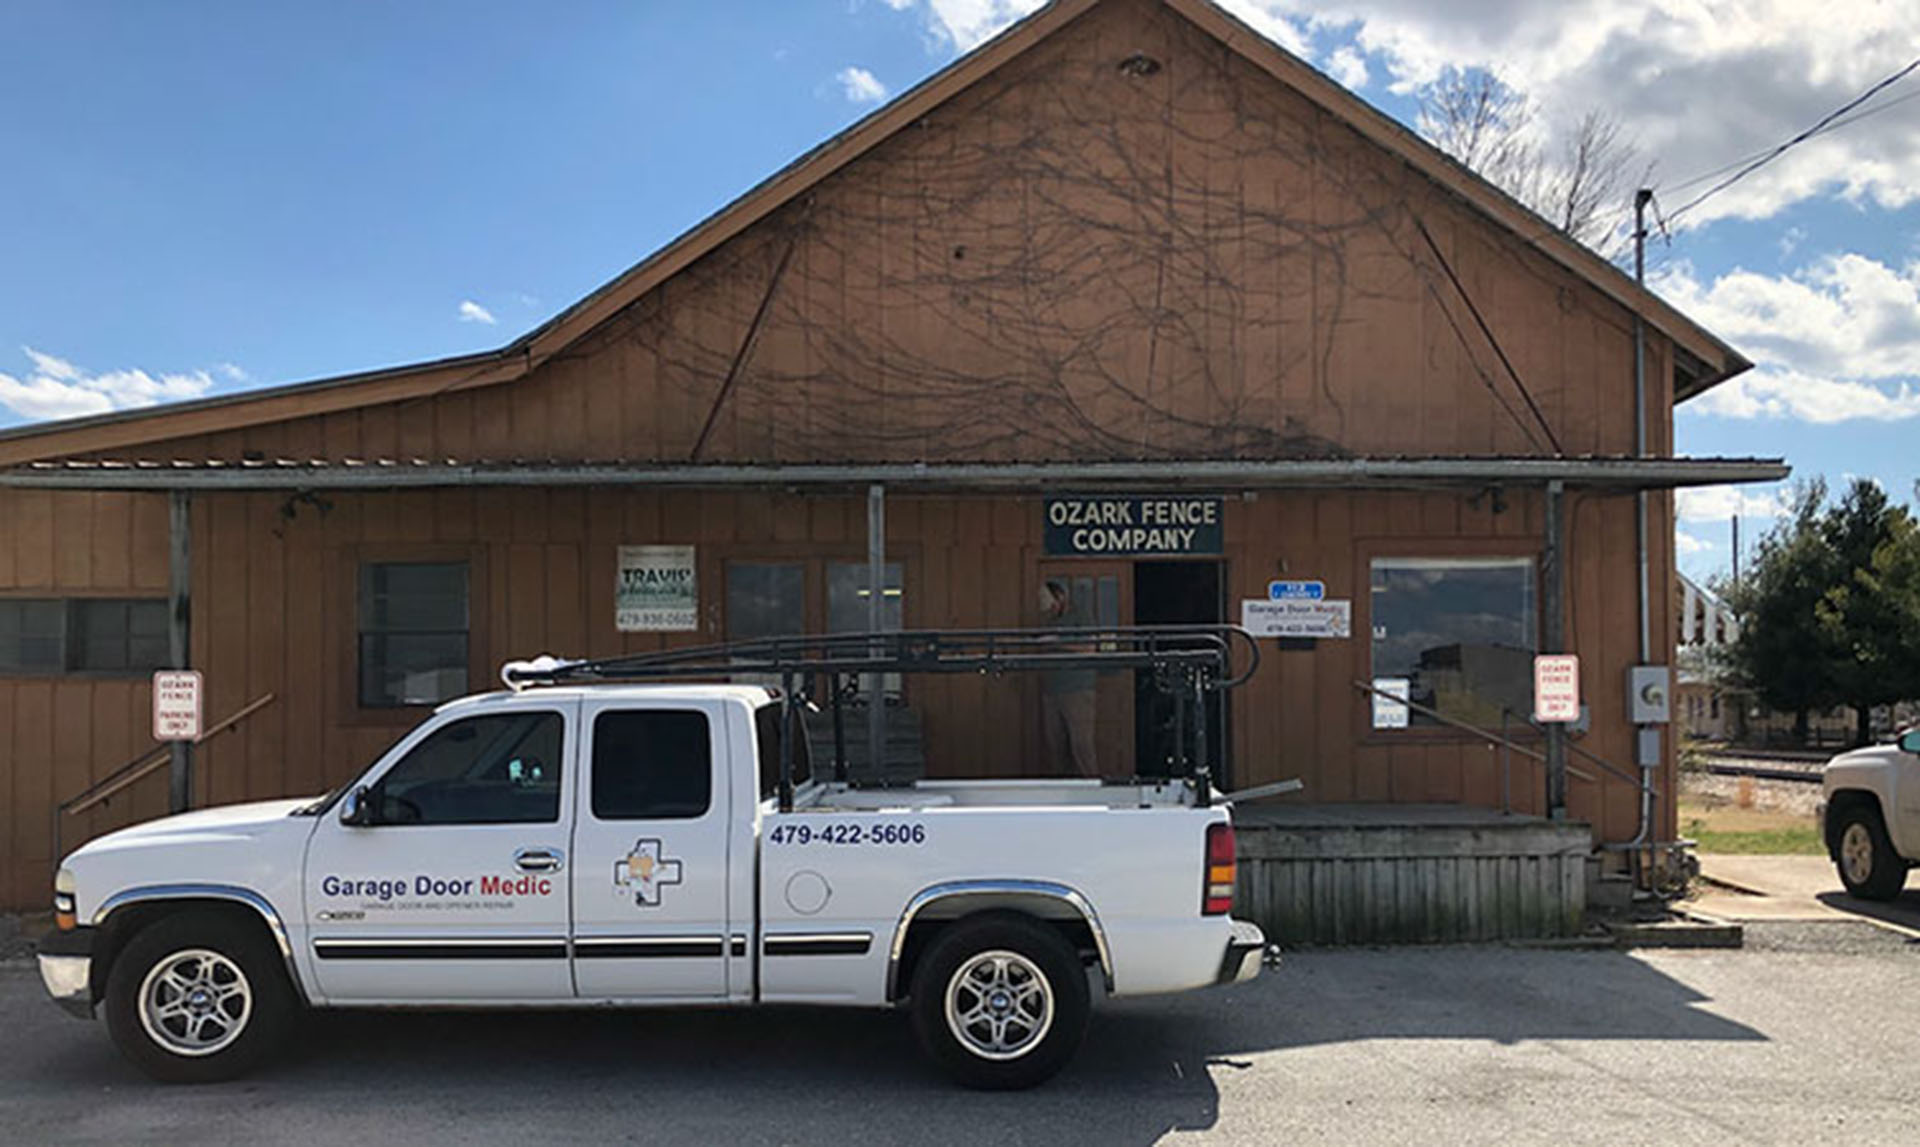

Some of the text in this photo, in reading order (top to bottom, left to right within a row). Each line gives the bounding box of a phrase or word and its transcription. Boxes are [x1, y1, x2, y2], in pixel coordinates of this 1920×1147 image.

[1049, 502, 1216, 525] OZARK FENCE
[1072, 529, 1195, 550] COMPANY
[1248, 603, 1285, 615] Garage
[1288, 604, 1312, 613] Door
[161, 680, 194, 689] OZARK
[162, 692, 193, 700] FENCE
[770, 825, 925, 844] 479-422-5606
[322, 876, 552, 900] Garage Door Medic
[399, 901, 422, 910] DOOR
